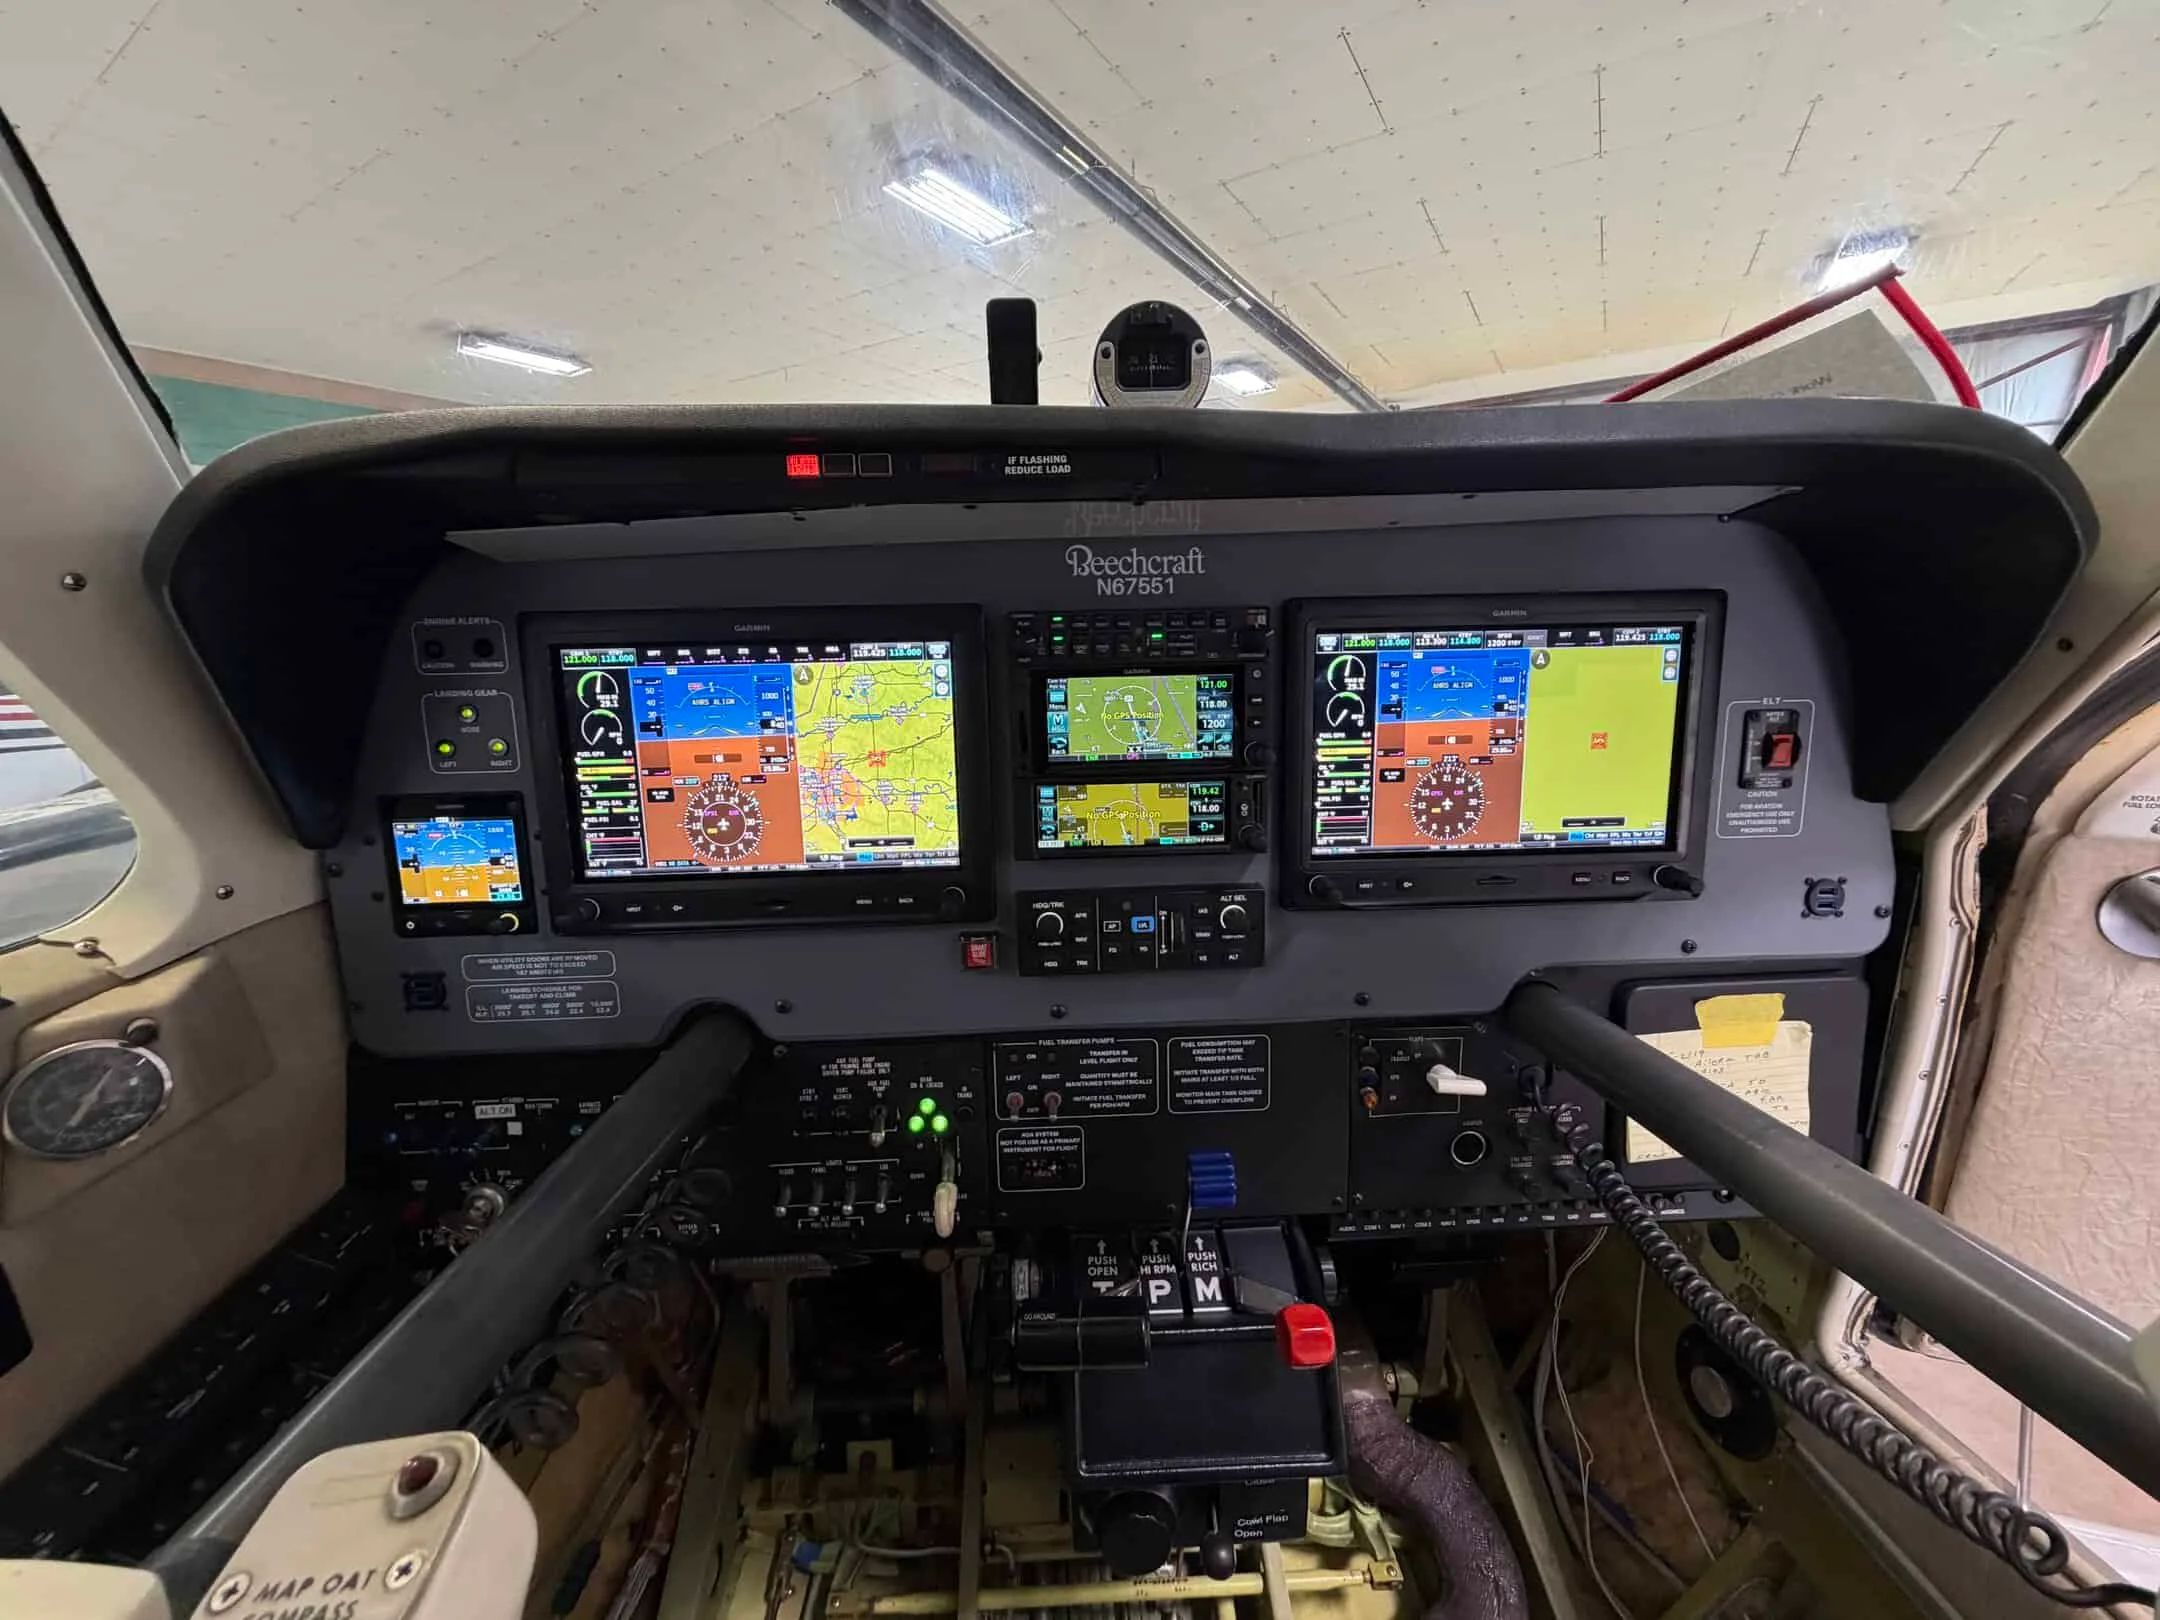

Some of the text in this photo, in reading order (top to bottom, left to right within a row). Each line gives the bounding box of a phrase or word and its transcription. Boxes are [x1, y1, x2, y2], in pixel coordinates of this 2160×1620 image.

[1008, 454, 1068, 464] IF FLASHING
[1004, 464, 1071, 474] REDUCE LOAD
[1065, 544, 1206, 578] Beechcraft
[1096, 578, 1175, 596] N67551
[1200, 680, 1228, 688] 121.00
[1200, 700, 1228, 708] 118.00
[1114, 712, 1130, 720] GPS
[1202, 720, 1226, 728] 1200
[1192, 787, 1220, 796] 119.42
[1192, 804, 1220, 813] 118.00
[1087, 810, 1099, 820] No
[1123, 810, 1160, 819] Position
[1056, 1038, 1090, 1046] TRANSFER
[1088, 1255, 1117, 1266] PUSH
[1142, 1254, 1170, 1264] PUSH
[1188, 1251, 1217, 1262] PUSH
[1088, 1266, 1118, 1276] OPEN
[1140, 1264, 1176, 1274] HI RPM
[1191, 1262, 1218, 1272] RICH
[1150, 1279, 1172, 1304] P
[1195, 1277, 1222, 1302] M
[1237, 1514, 1289, 1527] Cowl Flap
[1234, 1529, 1264, 1538] Open
[252, 1569, 377, 1602] MAP OAT
